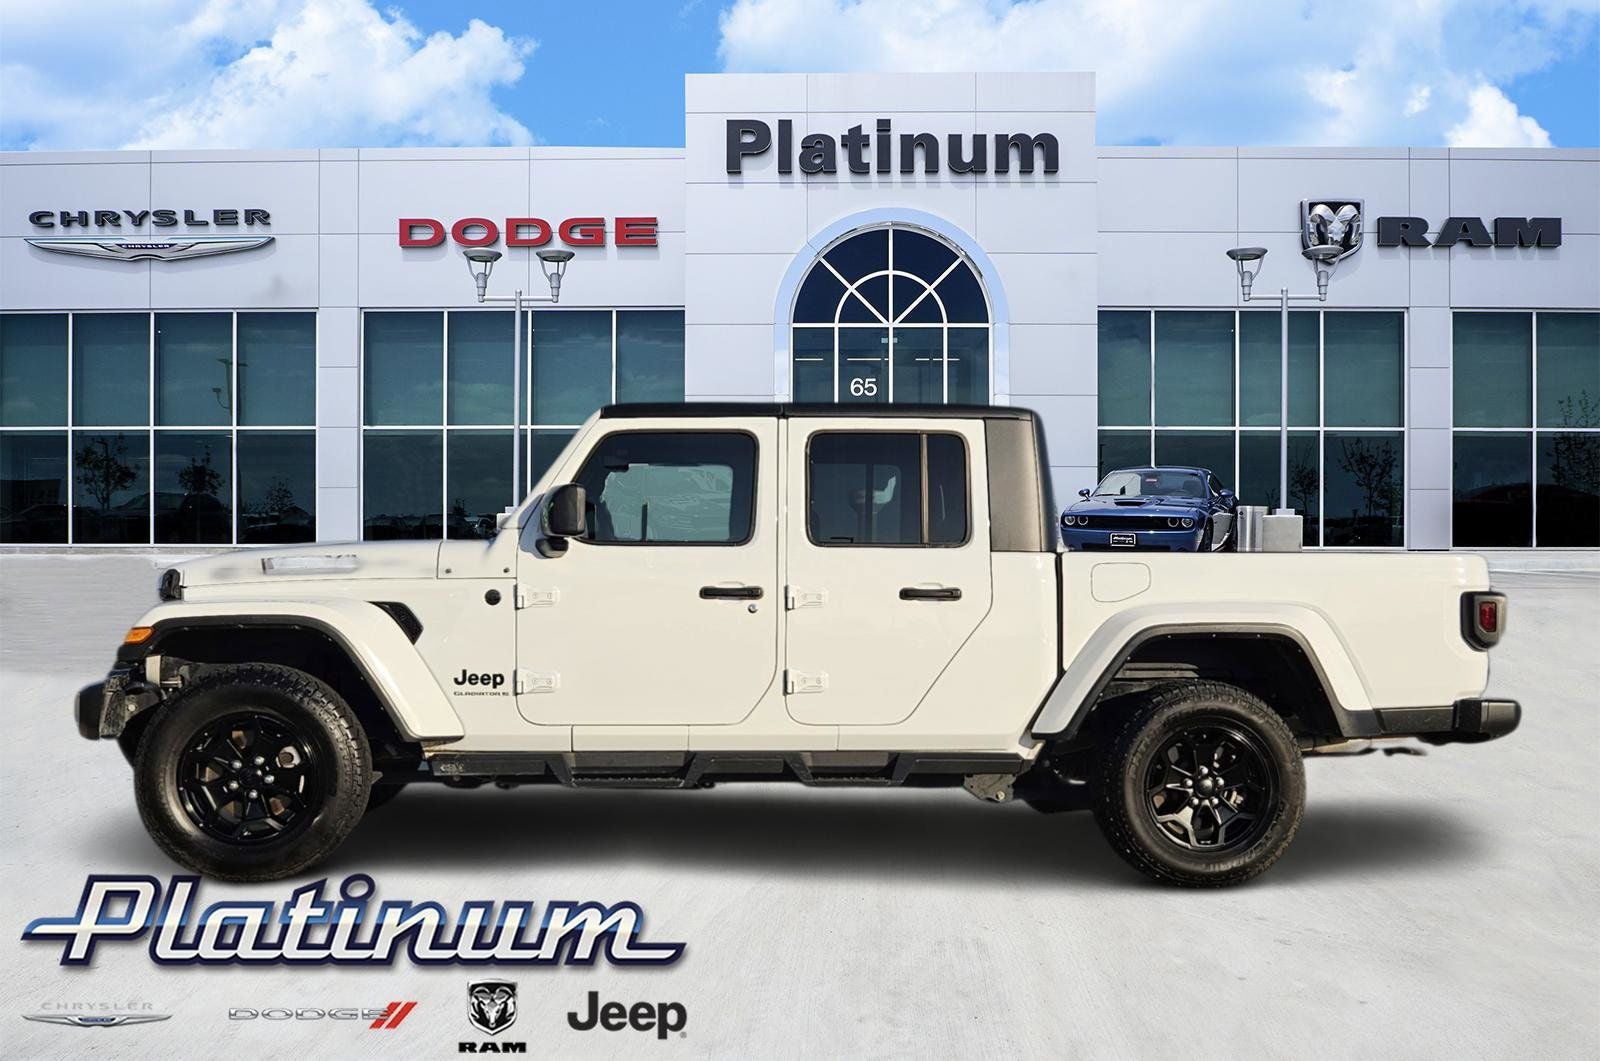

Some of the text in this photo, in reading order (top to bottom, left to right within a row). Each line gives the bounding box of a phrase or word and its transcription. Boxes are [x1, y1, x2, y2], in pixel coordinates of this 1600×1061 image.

[726, 119, 1060, 175] Platinum
[29, 209, 271, 228] CHRYSLER
[399, 217, 658, 249] DODGE
[1377, 216, 1562, 249] RAM
[850, 378, 878, 397] 65
[453, 669, 505, 689] Jeep
